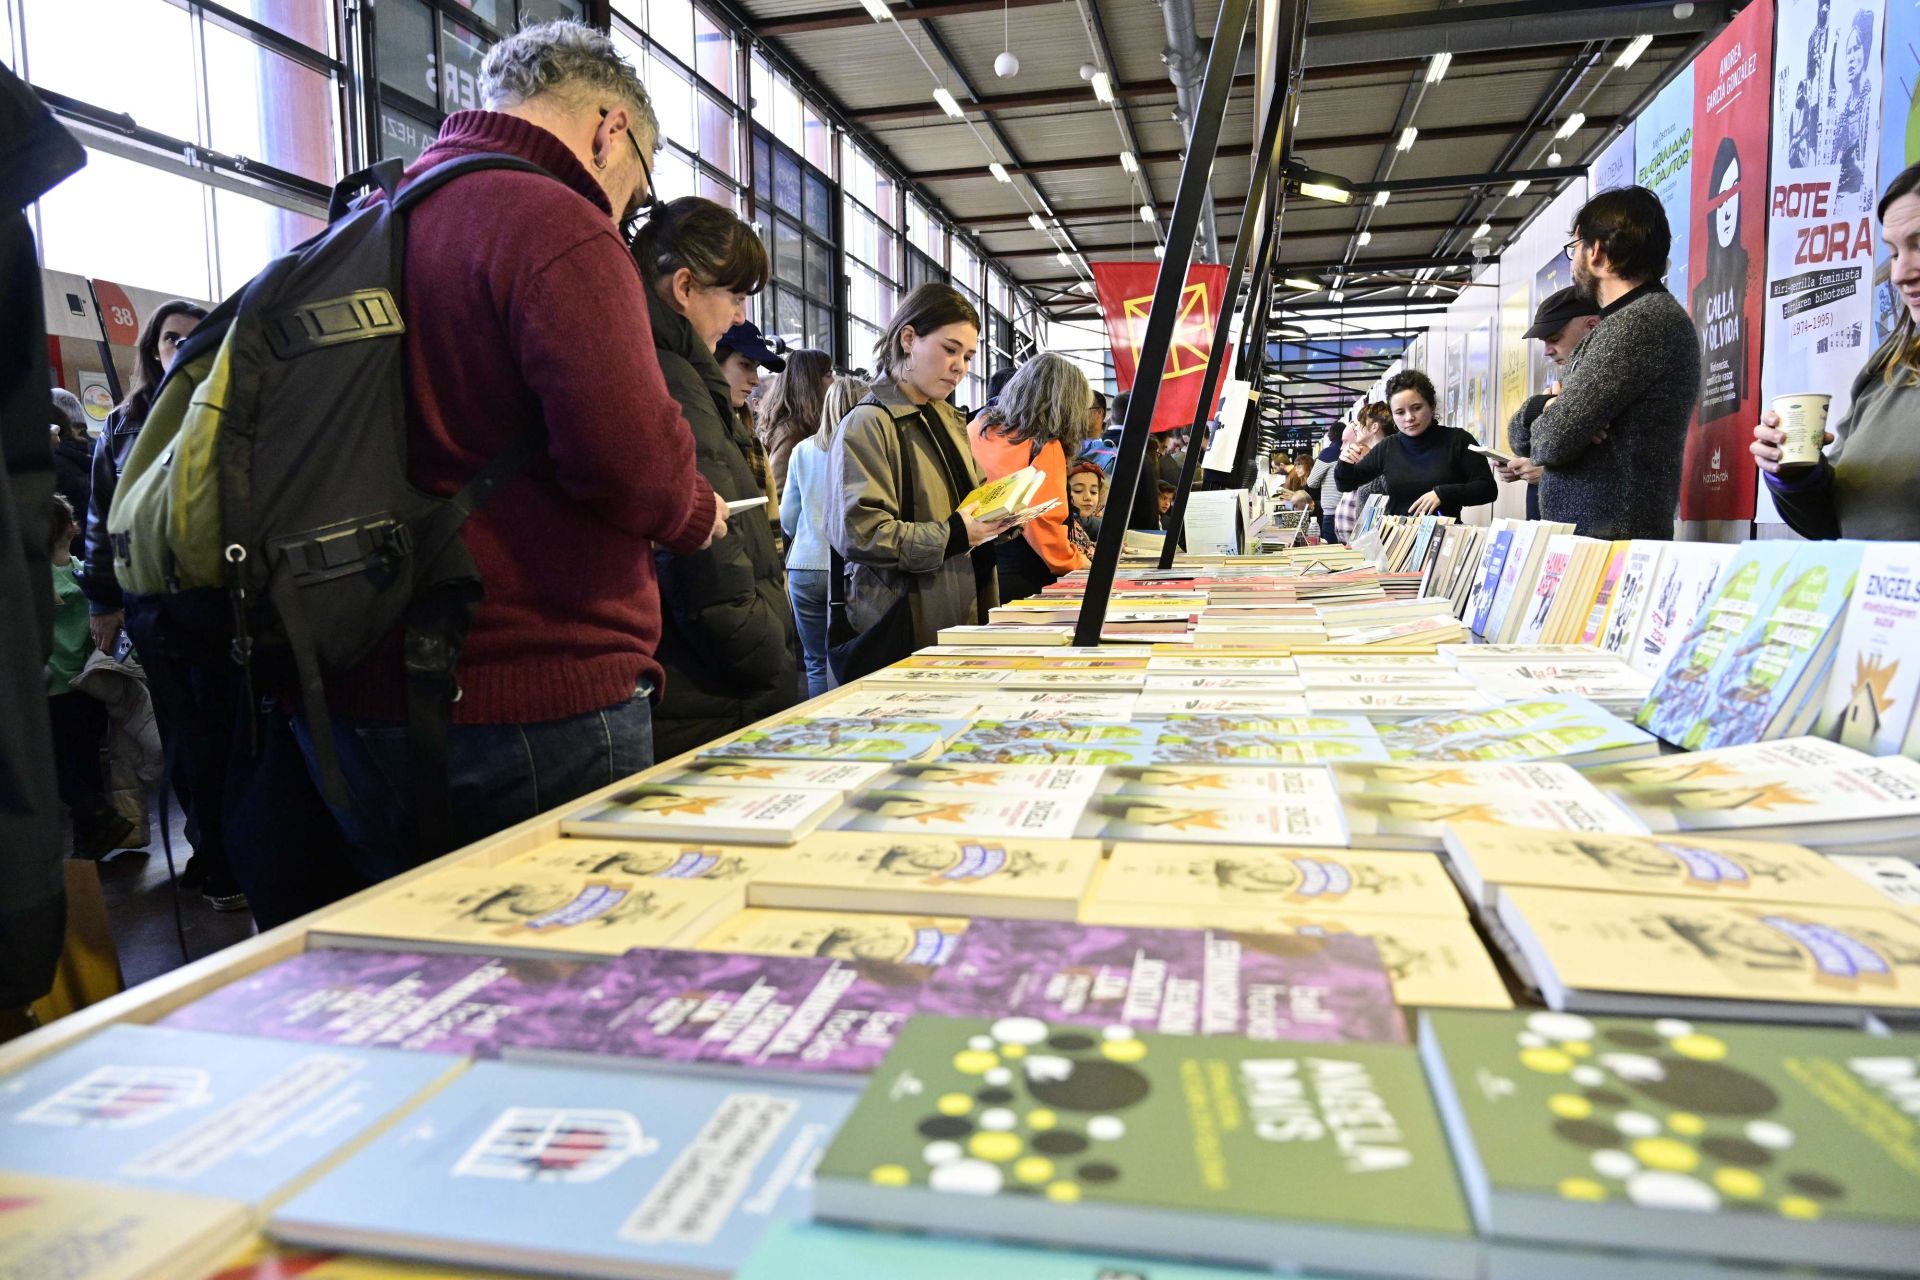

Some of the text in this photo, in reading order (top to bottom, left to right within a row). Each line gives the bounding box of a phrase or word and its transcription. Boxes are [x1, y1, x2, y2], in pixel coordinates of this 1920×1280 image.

[1719, 41, 1741, 79] ANDREA
[1650, 127, 1691, 174] CIRUJANO
[1655, 148, 1689, 187] PASTOR
[1771, 182, 1831, 219] ROTE
[1794, 217, 1873, 265] ZORA
[1815, 284, 1855, 304] bihotzean
[1818, 268, 1861, 286] feminista
[111, 305, 134, 327] 38
[1706, 286, 1734, 325] CALLA
[1702, 313, 1740, 356] Y OLVIDA
[1865, 573, 1920, 603] ENGELS
